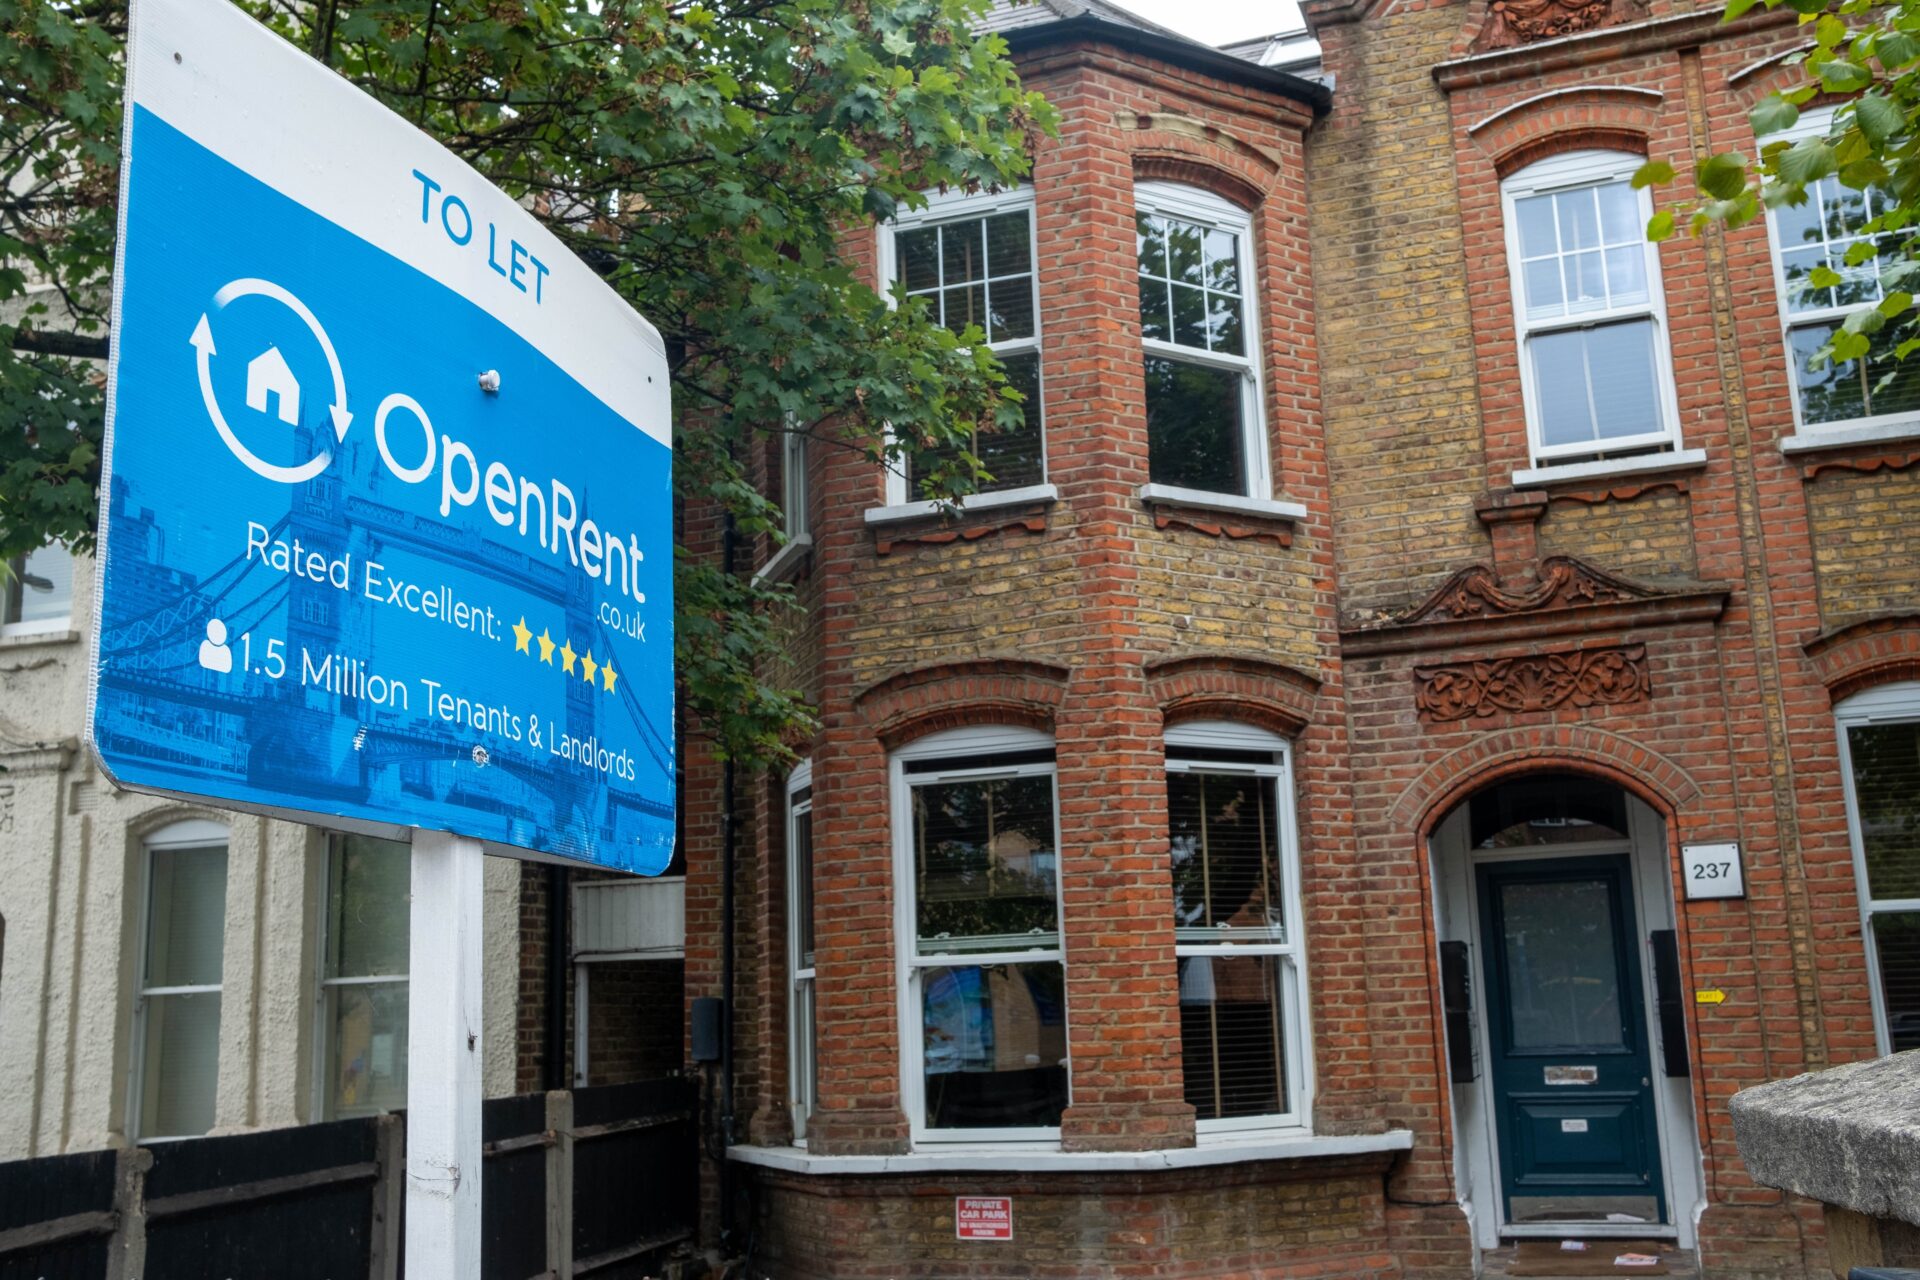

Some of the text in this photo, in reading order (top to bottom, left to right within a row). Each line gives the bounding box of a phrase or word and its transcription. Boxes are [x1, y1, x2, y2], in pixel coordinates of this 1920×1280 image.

[412, 168, 550, 304] TO LET
[374, 392, 646, 604] OpenRent
[246, 520, 502, 642] Rated Excellent:
[596, 602, 646, 643] .co.uk
[241, 632, 636, 782] 1.5 Million Tenants & Landlords
[1693, 862, 1731, 880] 237
[960, 1210, 1008, 1219] CAR PARK
[965, 1200, 1002, 1209] PRIVATE
